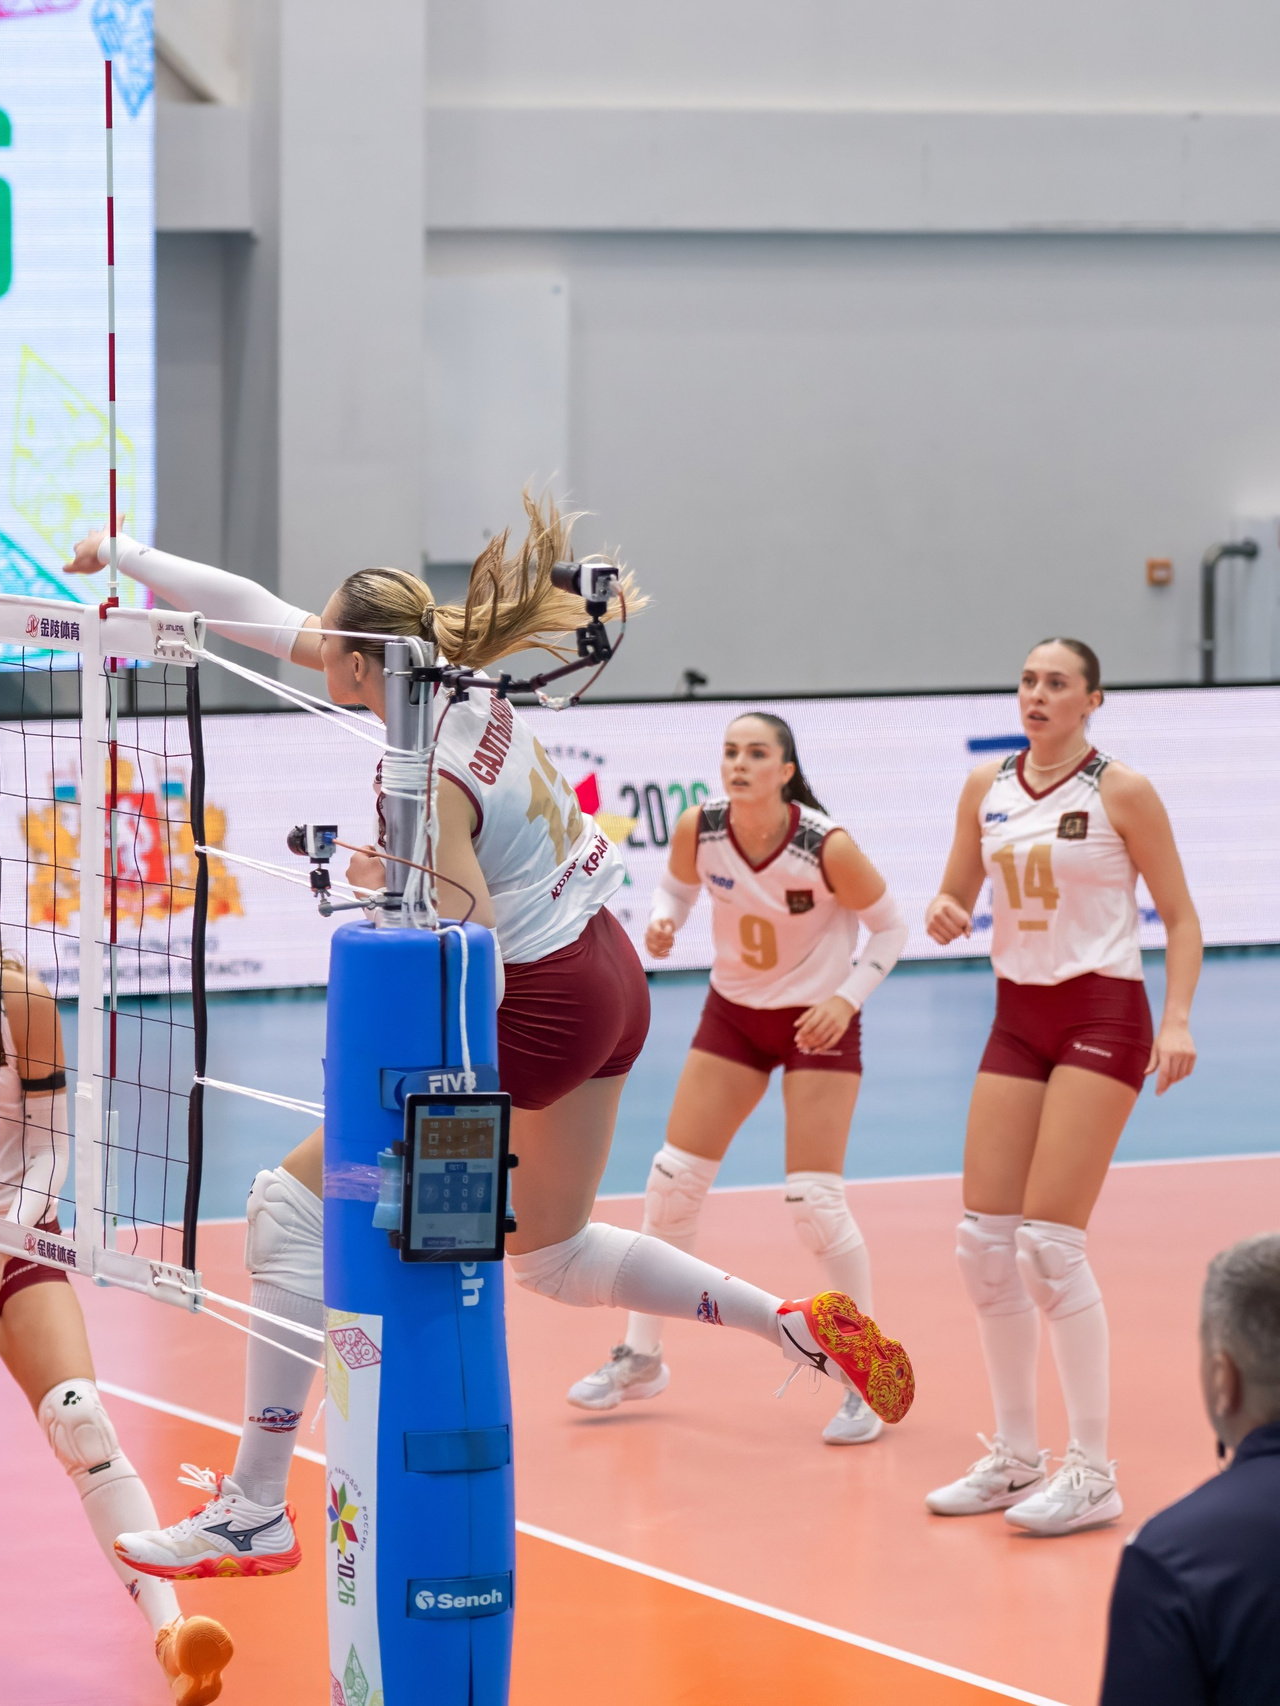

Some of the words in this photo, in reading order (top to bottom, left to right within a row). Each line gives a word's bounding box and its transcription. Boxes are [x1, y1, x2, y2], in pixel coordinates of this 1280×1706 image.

[40, 618, 80, 641] 金陵体育
[581, 834, 609, 877] КРАЙ
[991, 844, 1061, 910] 14
[738, 914, 778, 972] 9
[37, 1238, 77, 1268] 金陵体育
[361, 1506, 369, 1551] РОССИИ
[337, 1548, 356, 1607] 2026
[437, 1589, 502, 1609] Senoh
